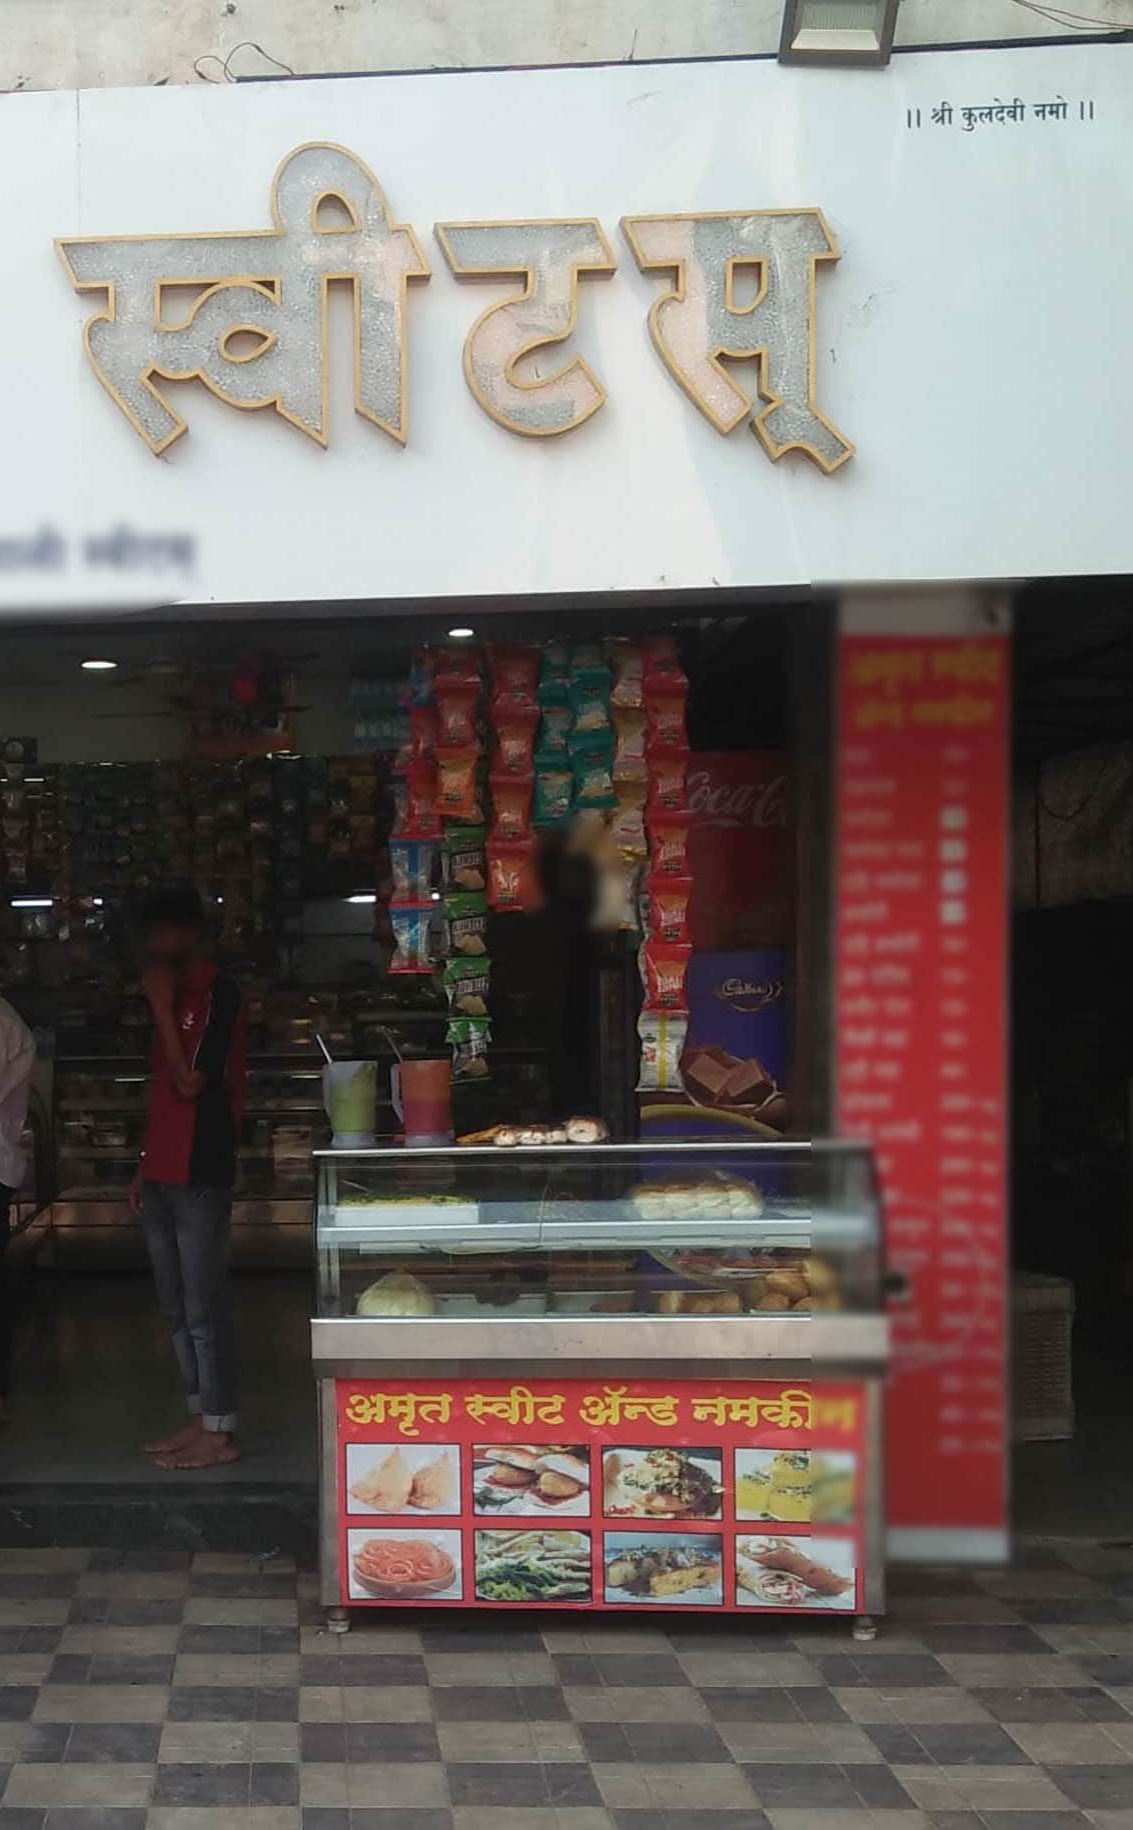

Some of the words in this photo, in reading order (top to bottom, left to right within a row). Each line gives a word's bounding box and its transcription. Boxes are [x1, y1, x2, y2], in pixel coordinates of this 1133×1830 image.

[931, 101, 953, 126] श्री
[961, 98, 1026, 132] कुलदेवी
[1034, 95, 1068, 121] नमो
[53, 141, 857, 475] स्वीटस्
[345, 1392, 452, 1437] अमृत
[465, 1387, 565, 1426] स्वीट
